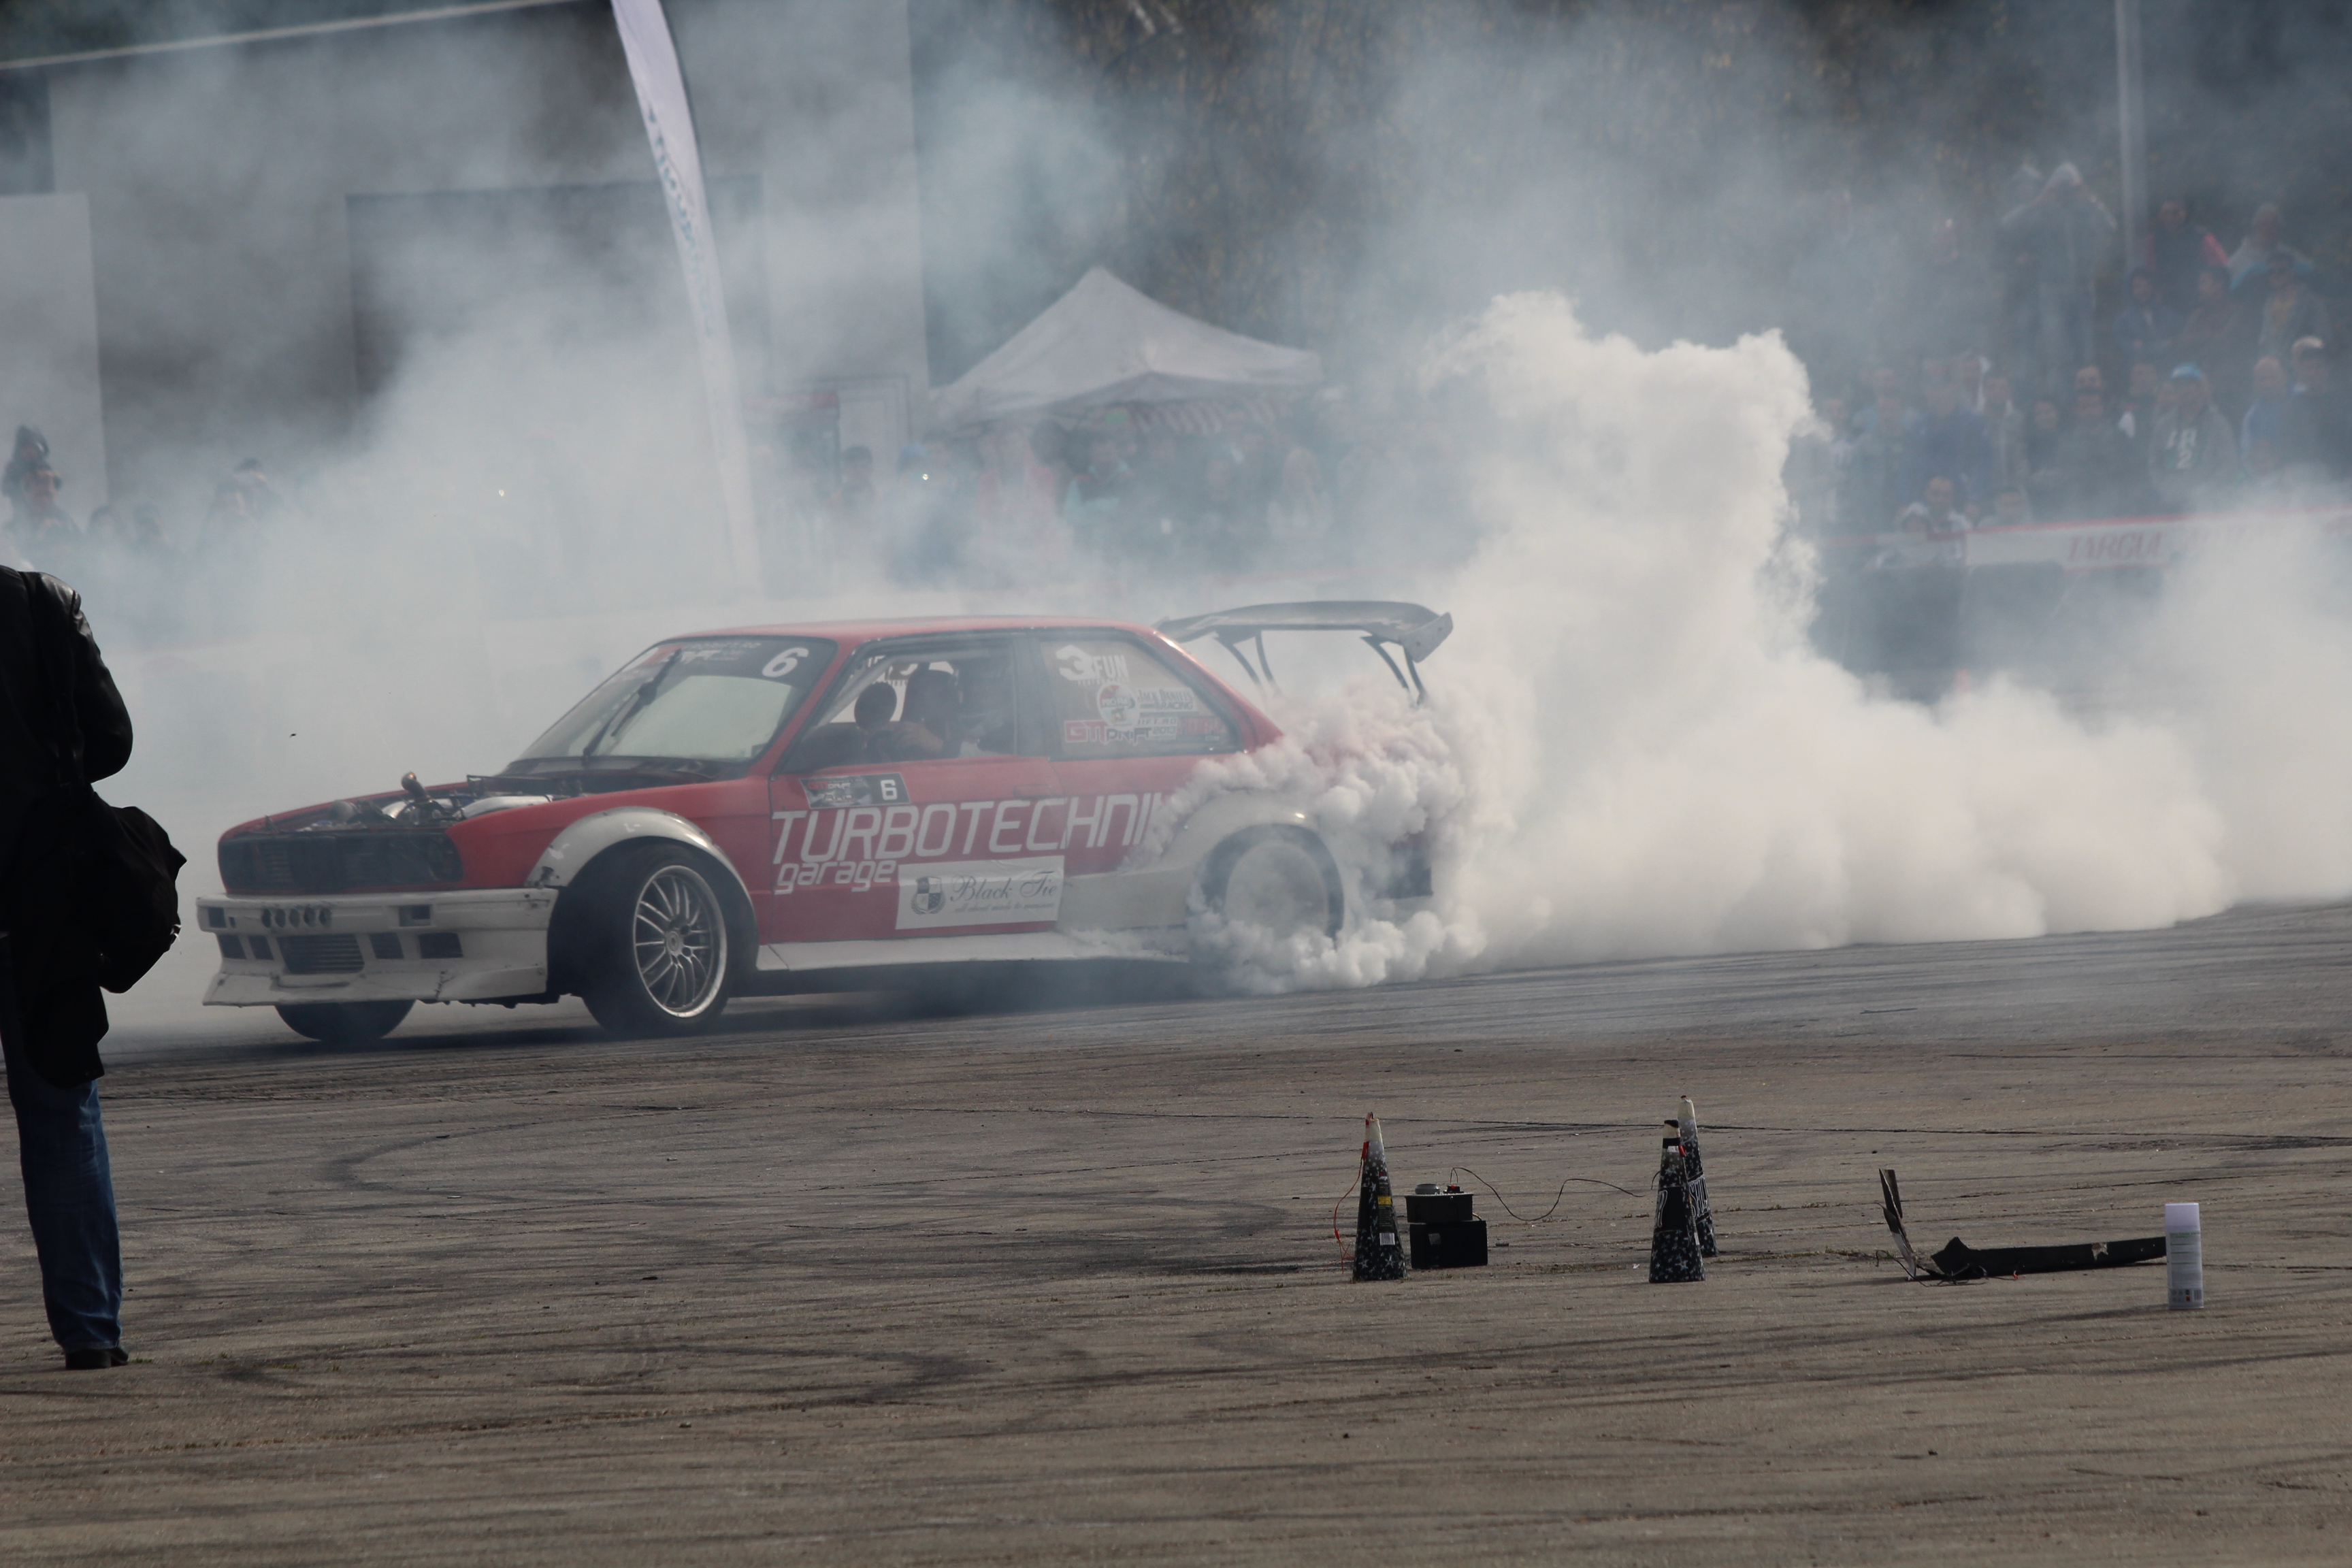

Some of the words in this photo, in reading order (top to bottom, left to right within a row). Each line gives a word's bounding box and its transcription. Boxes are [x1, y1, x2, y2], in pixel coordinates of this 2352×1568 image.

[762, 647, 810, 678] 6
[1093, 654, 1129, 680] FUN
[880, 779, 898, 801] 6
[774, 860, 897, 896] garage
[950, 875, 1013, 902] Black
[1019, 870, 1058, 898] Tie
